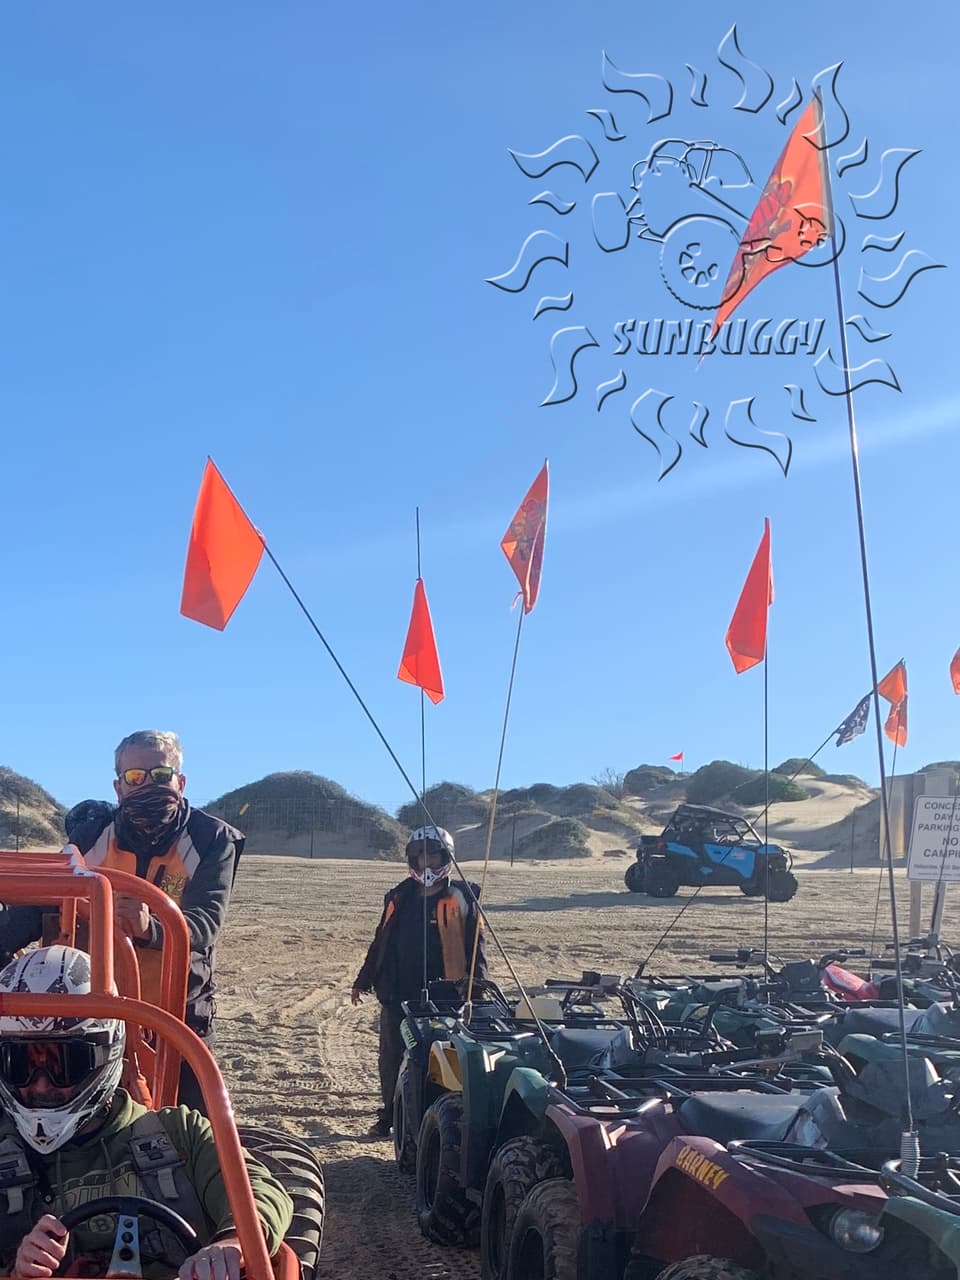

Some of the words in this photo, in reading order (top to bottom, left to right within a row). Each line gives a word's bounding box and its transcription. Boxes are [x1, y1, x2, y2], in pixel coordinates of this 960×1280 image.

[934, 813, 952, 821] DAY
[918, 823, 960, 832] PARKING
[942, 837, 959, 846] NO
[676, 1145, 730, 1190] BARNEY
